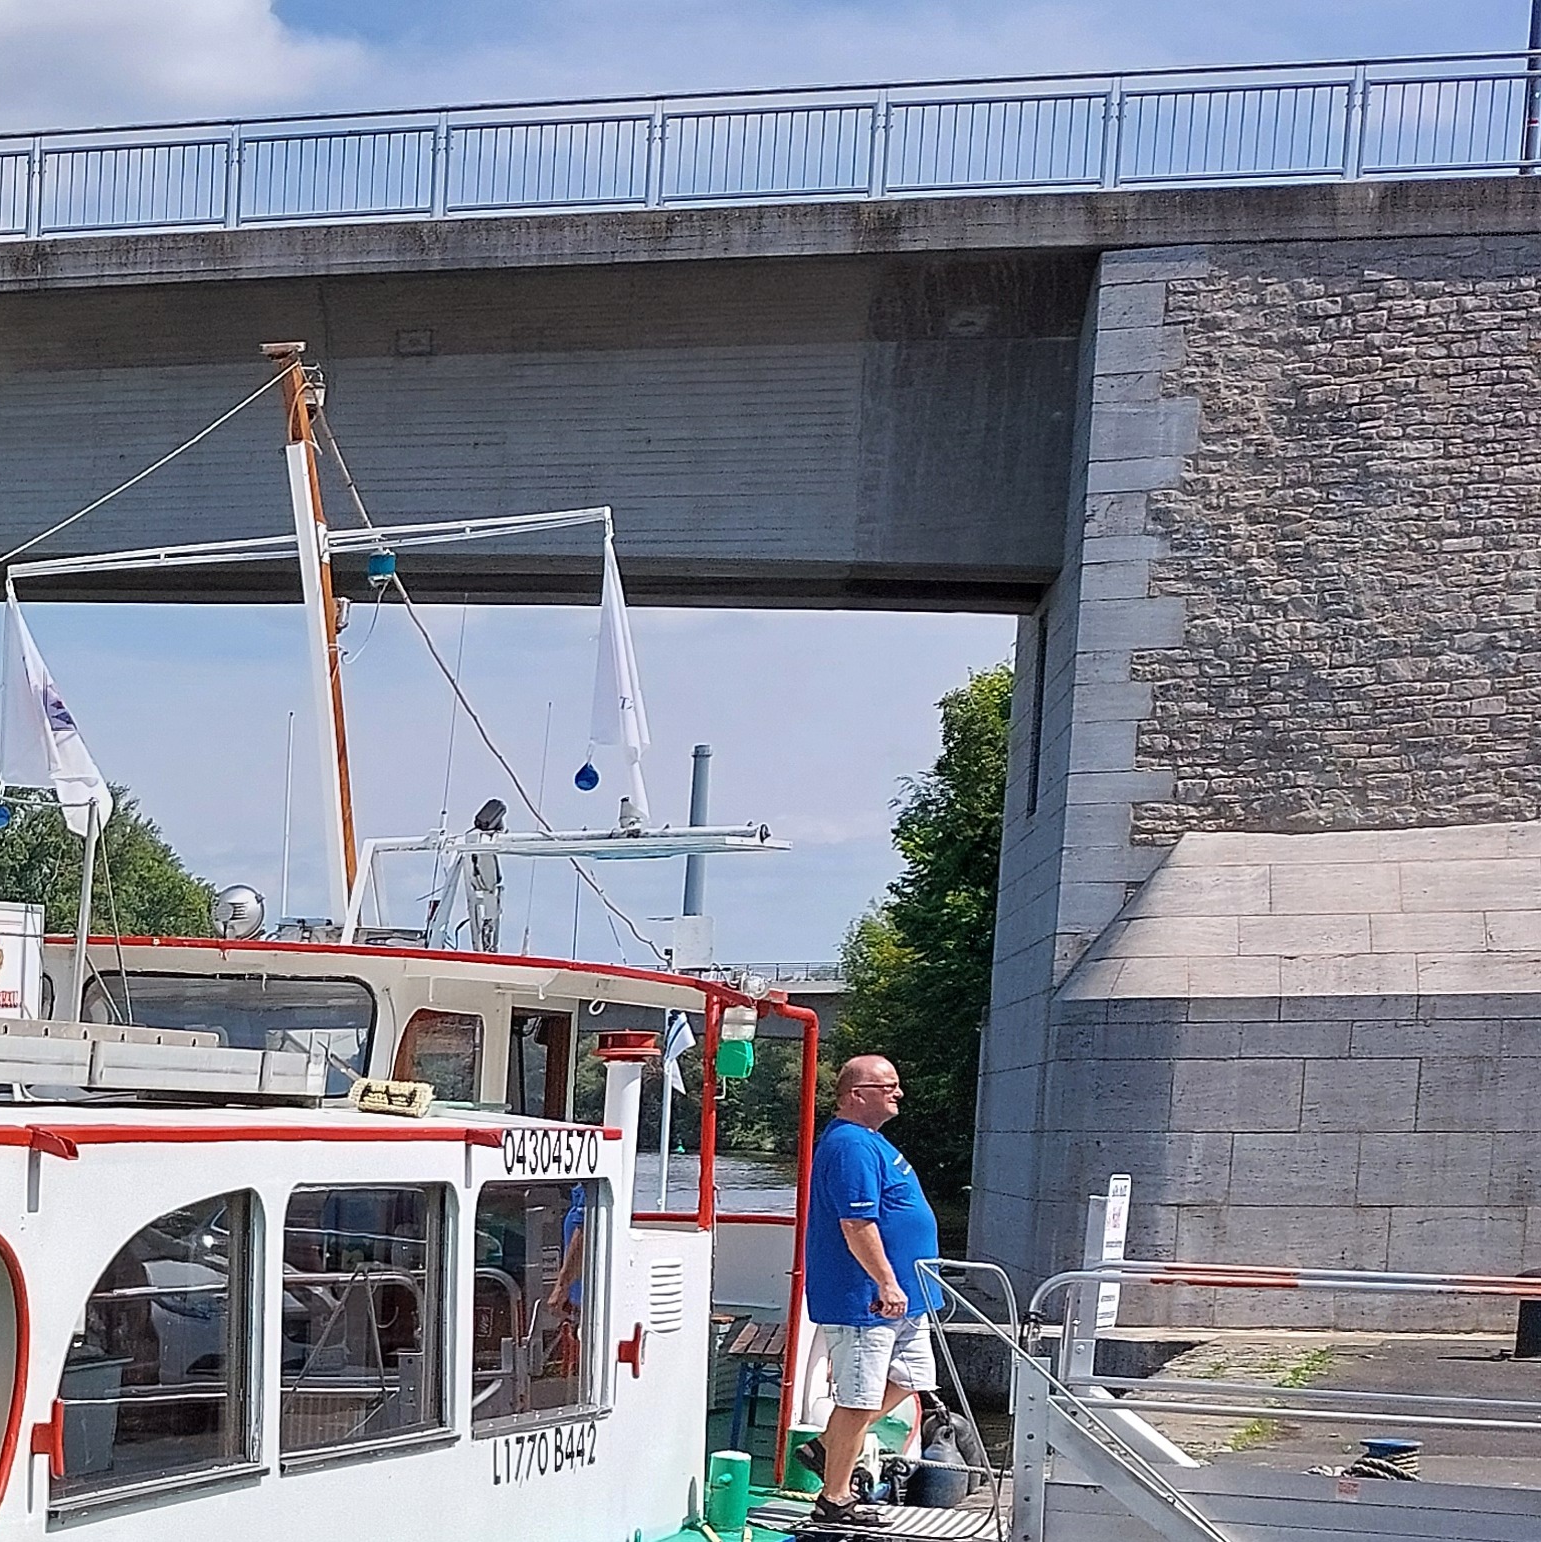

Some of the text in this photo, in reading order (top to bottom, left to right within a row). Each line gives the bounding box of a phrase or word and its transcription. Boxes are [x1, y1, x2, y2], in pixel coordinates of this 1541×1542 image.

[503, 1128, 598, 1175] 04304570
[493, 1420, 597, 1485] L1770 B442
